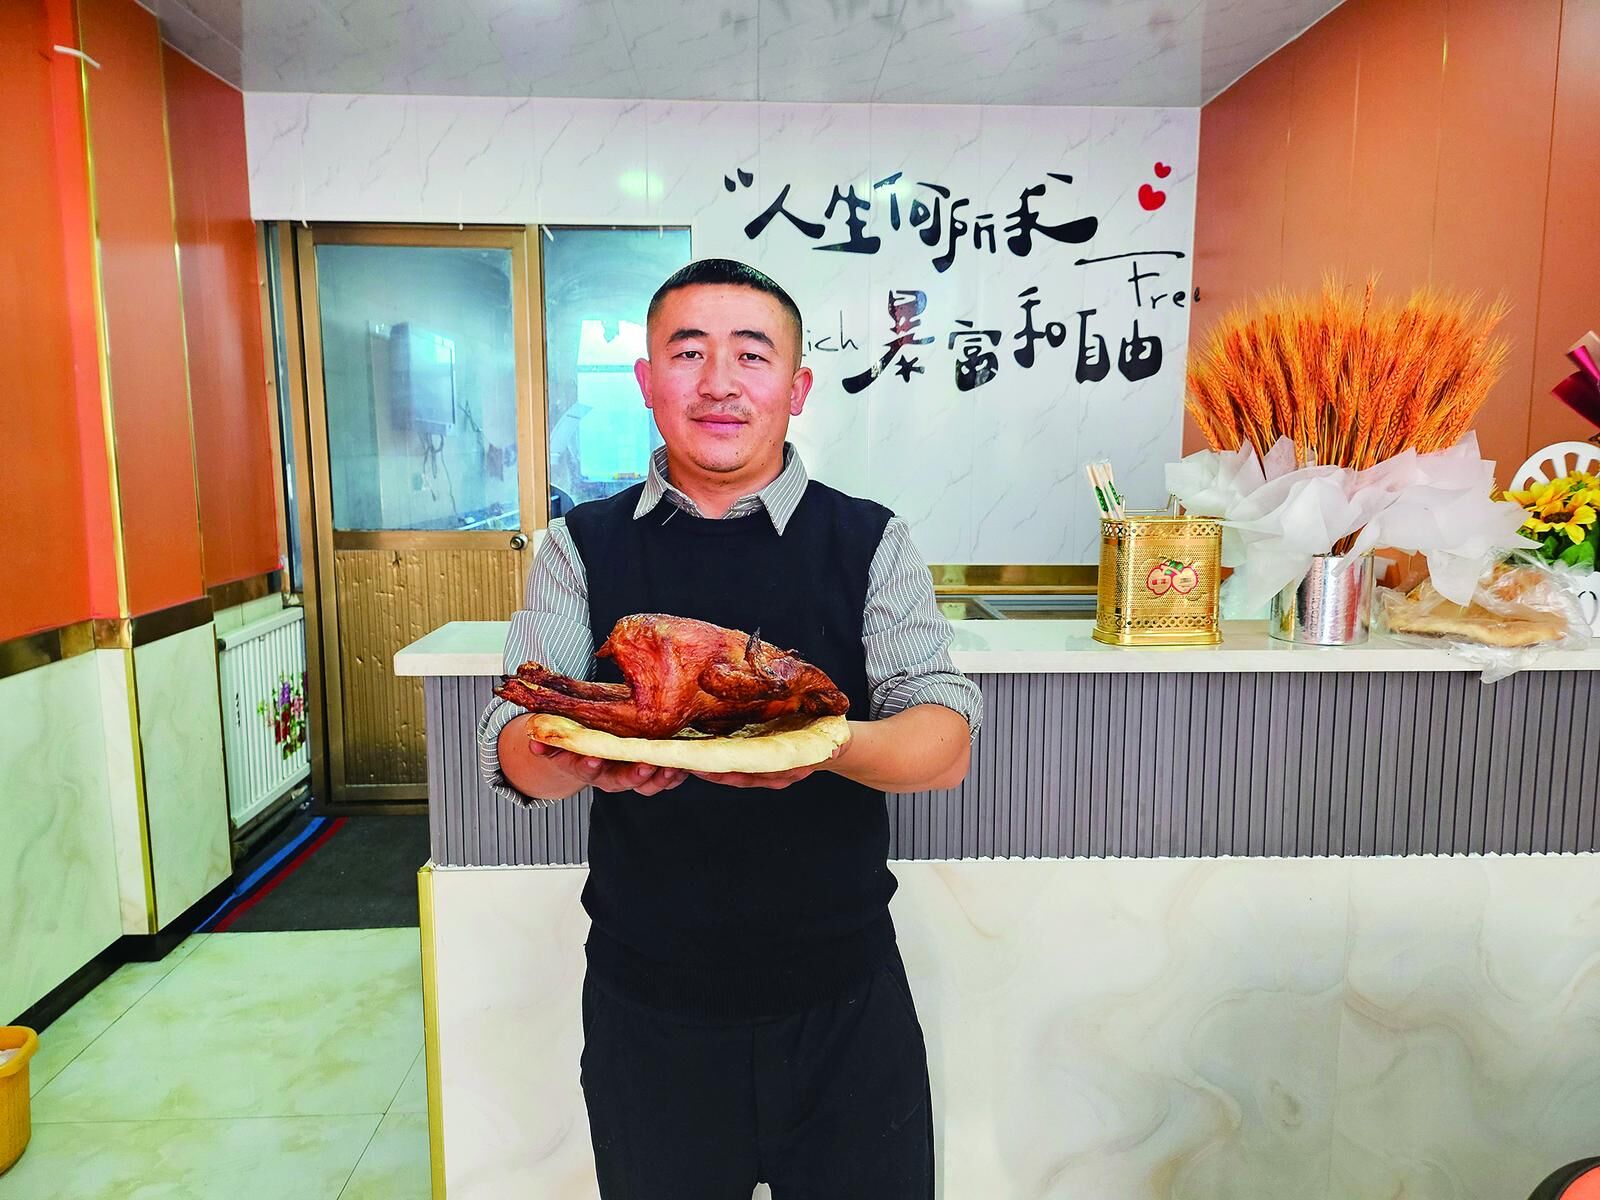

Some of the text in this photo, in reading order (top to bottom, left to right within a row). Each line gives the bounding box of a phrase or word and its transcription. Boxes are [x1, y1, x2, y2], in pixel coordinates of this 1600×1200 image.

[802, 310, 858, 356] ich
[842, 286, 1163, 394] 暴富和自由
